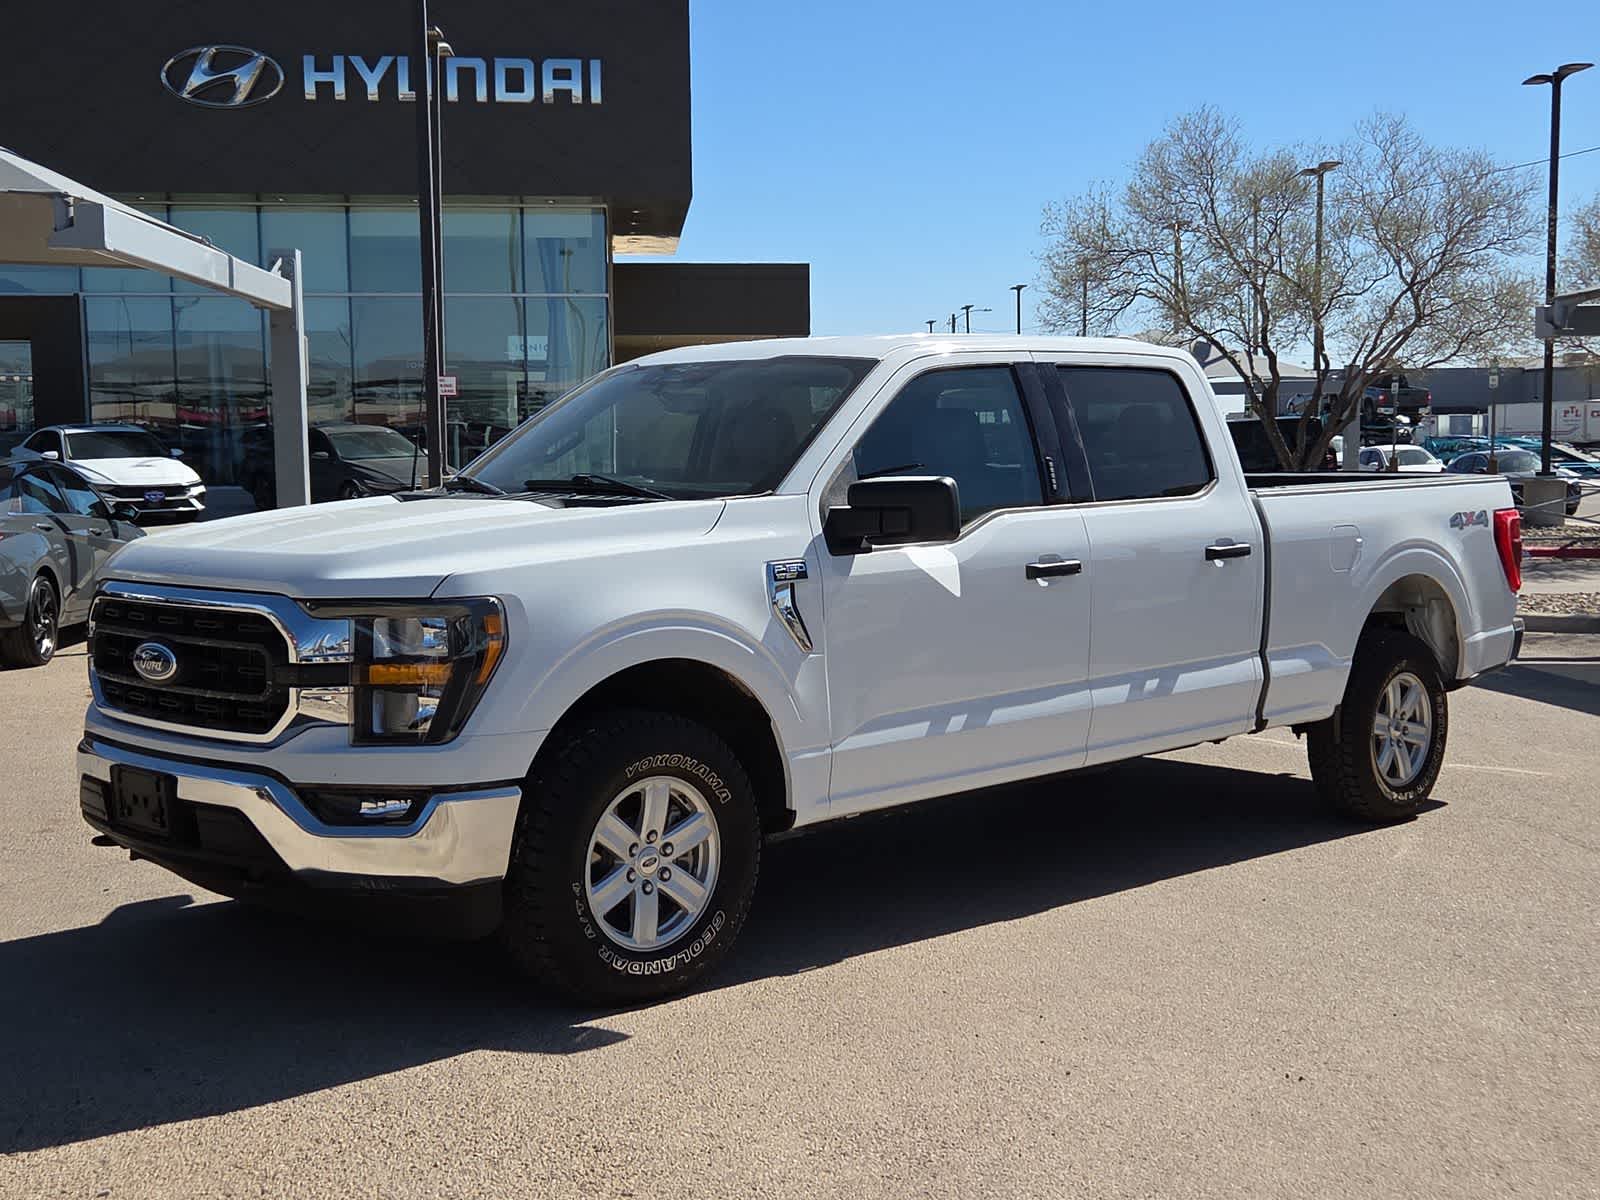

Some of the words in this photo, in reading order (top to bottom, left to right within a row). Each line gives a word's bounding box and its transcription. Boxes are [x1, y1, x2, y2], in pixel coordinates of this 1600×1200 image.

[139, 649, 165, 672] Ford
[625, 754, 731, 804] YOKOHAMA
[598, 910, 725, 975] GEOLANDAR
